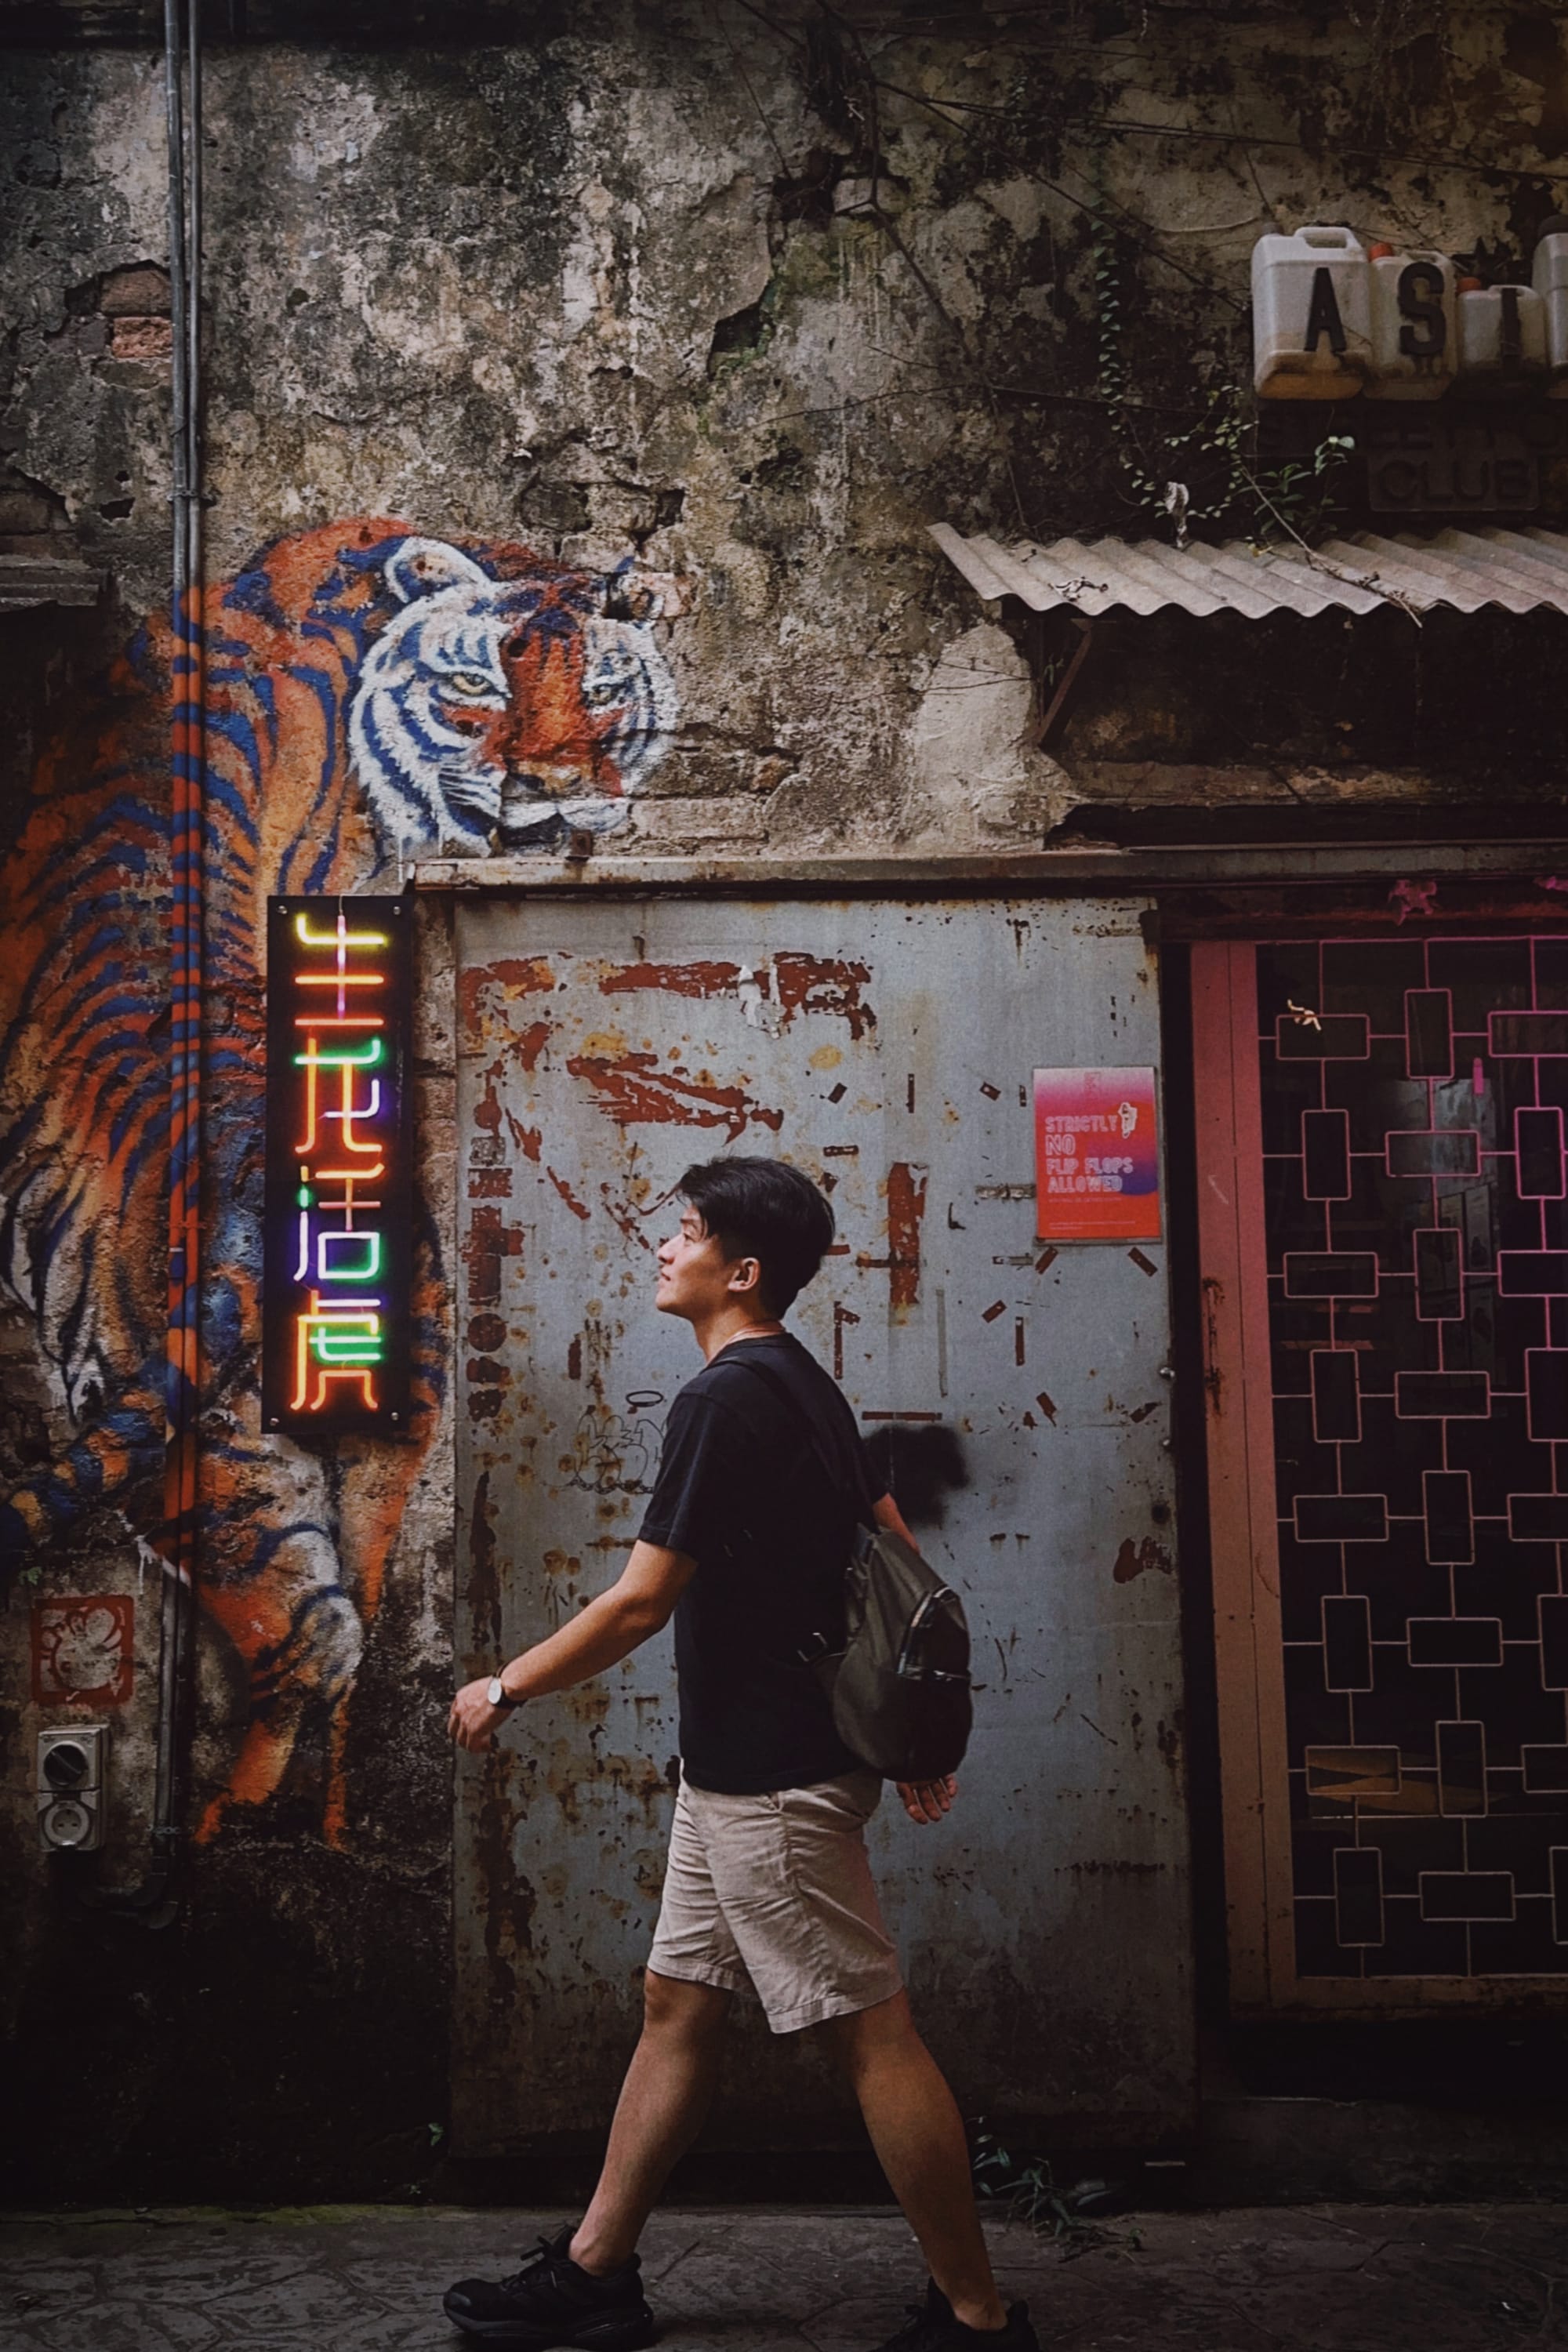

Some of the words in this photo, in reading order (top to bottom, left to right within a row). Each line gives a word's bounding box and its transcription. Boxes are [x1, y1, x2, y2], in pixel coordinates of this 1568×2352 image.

[1378, 459, 1532, 500] CLUB
[1045, 1115, 1118, 1133] STRICTLY
[1045, 1134, 1076, 1156] NO
[1046, 1158, 1080, 1174] FLIP
[1084, 1156, 1134, 1174] FLOPS
[1047, 1175, 1123, 1193] ALLOWED
